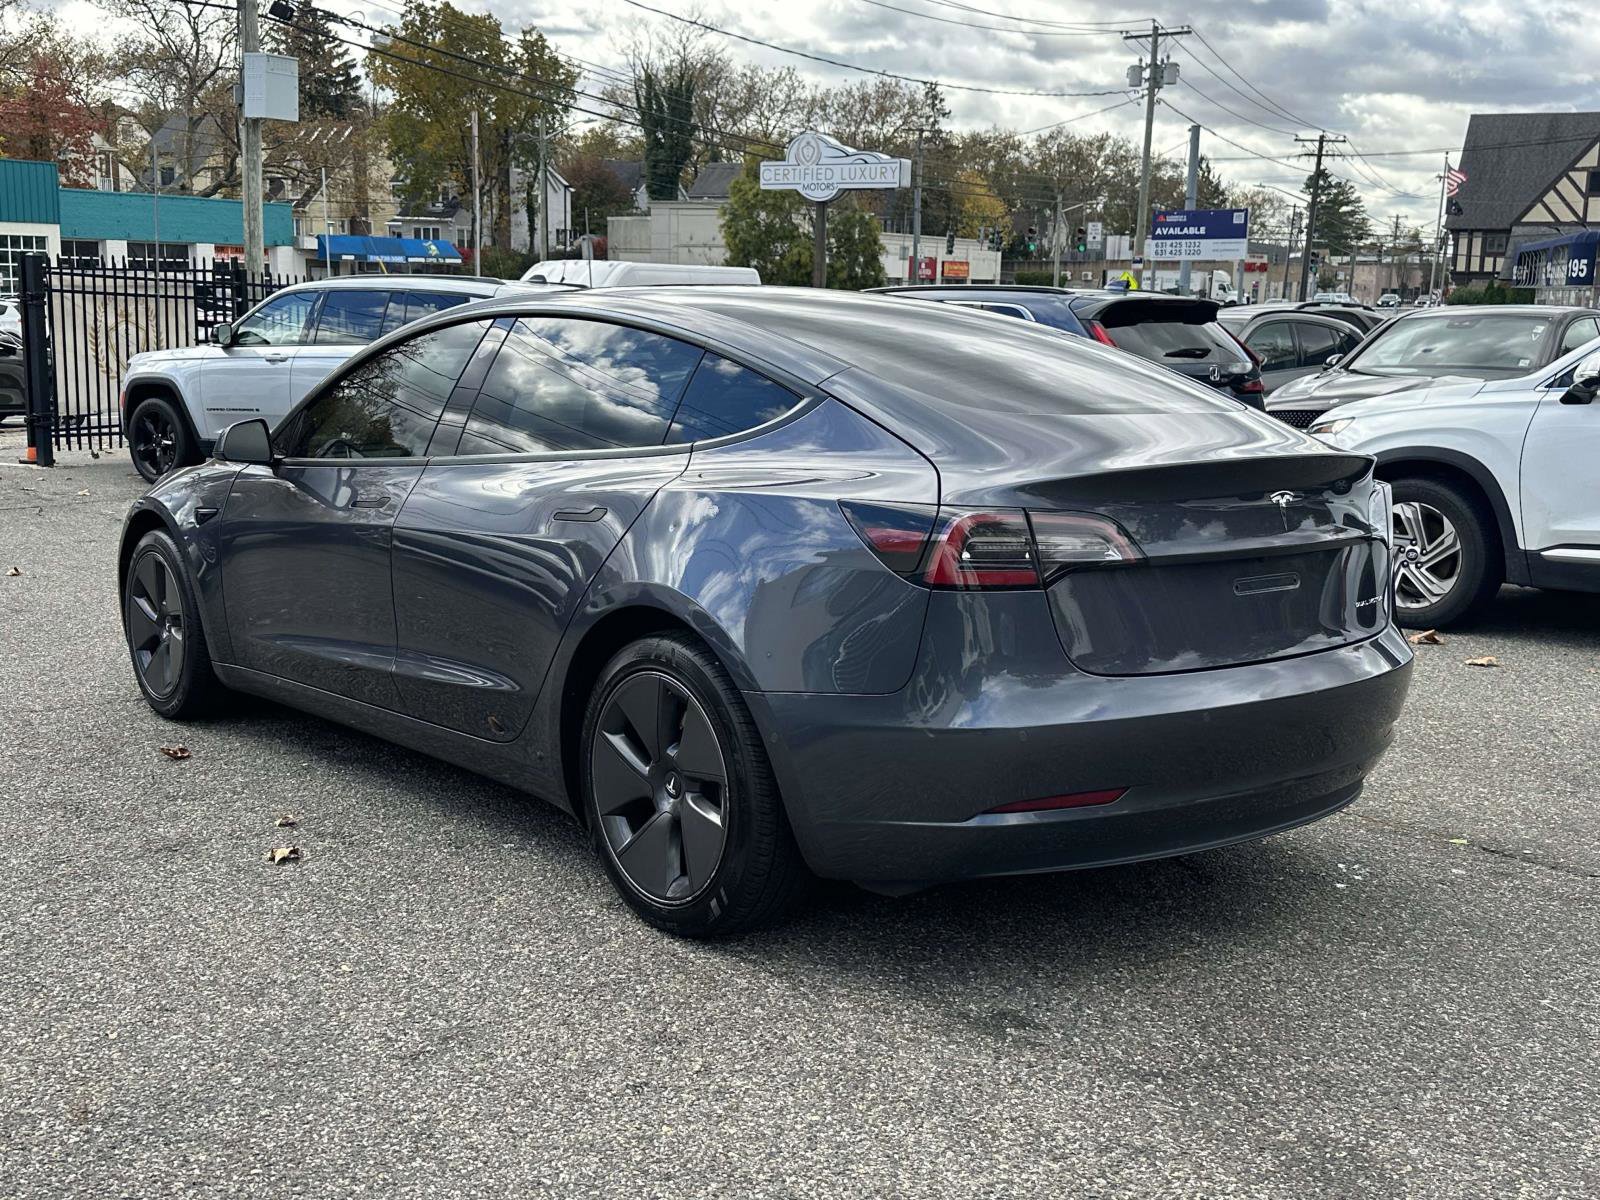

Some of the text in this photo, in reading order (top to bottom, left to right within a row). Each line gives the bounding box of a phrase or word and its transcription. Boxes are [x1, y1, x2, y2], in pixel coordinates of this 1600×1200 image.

[761, 166, 898, 182] CERTIFIED LUXURY
[802, 183, 835, 192] MOTORS
[1155, 226, 1206, 235] AVAILABLE
[1568, 258, 1588, 278] 195
